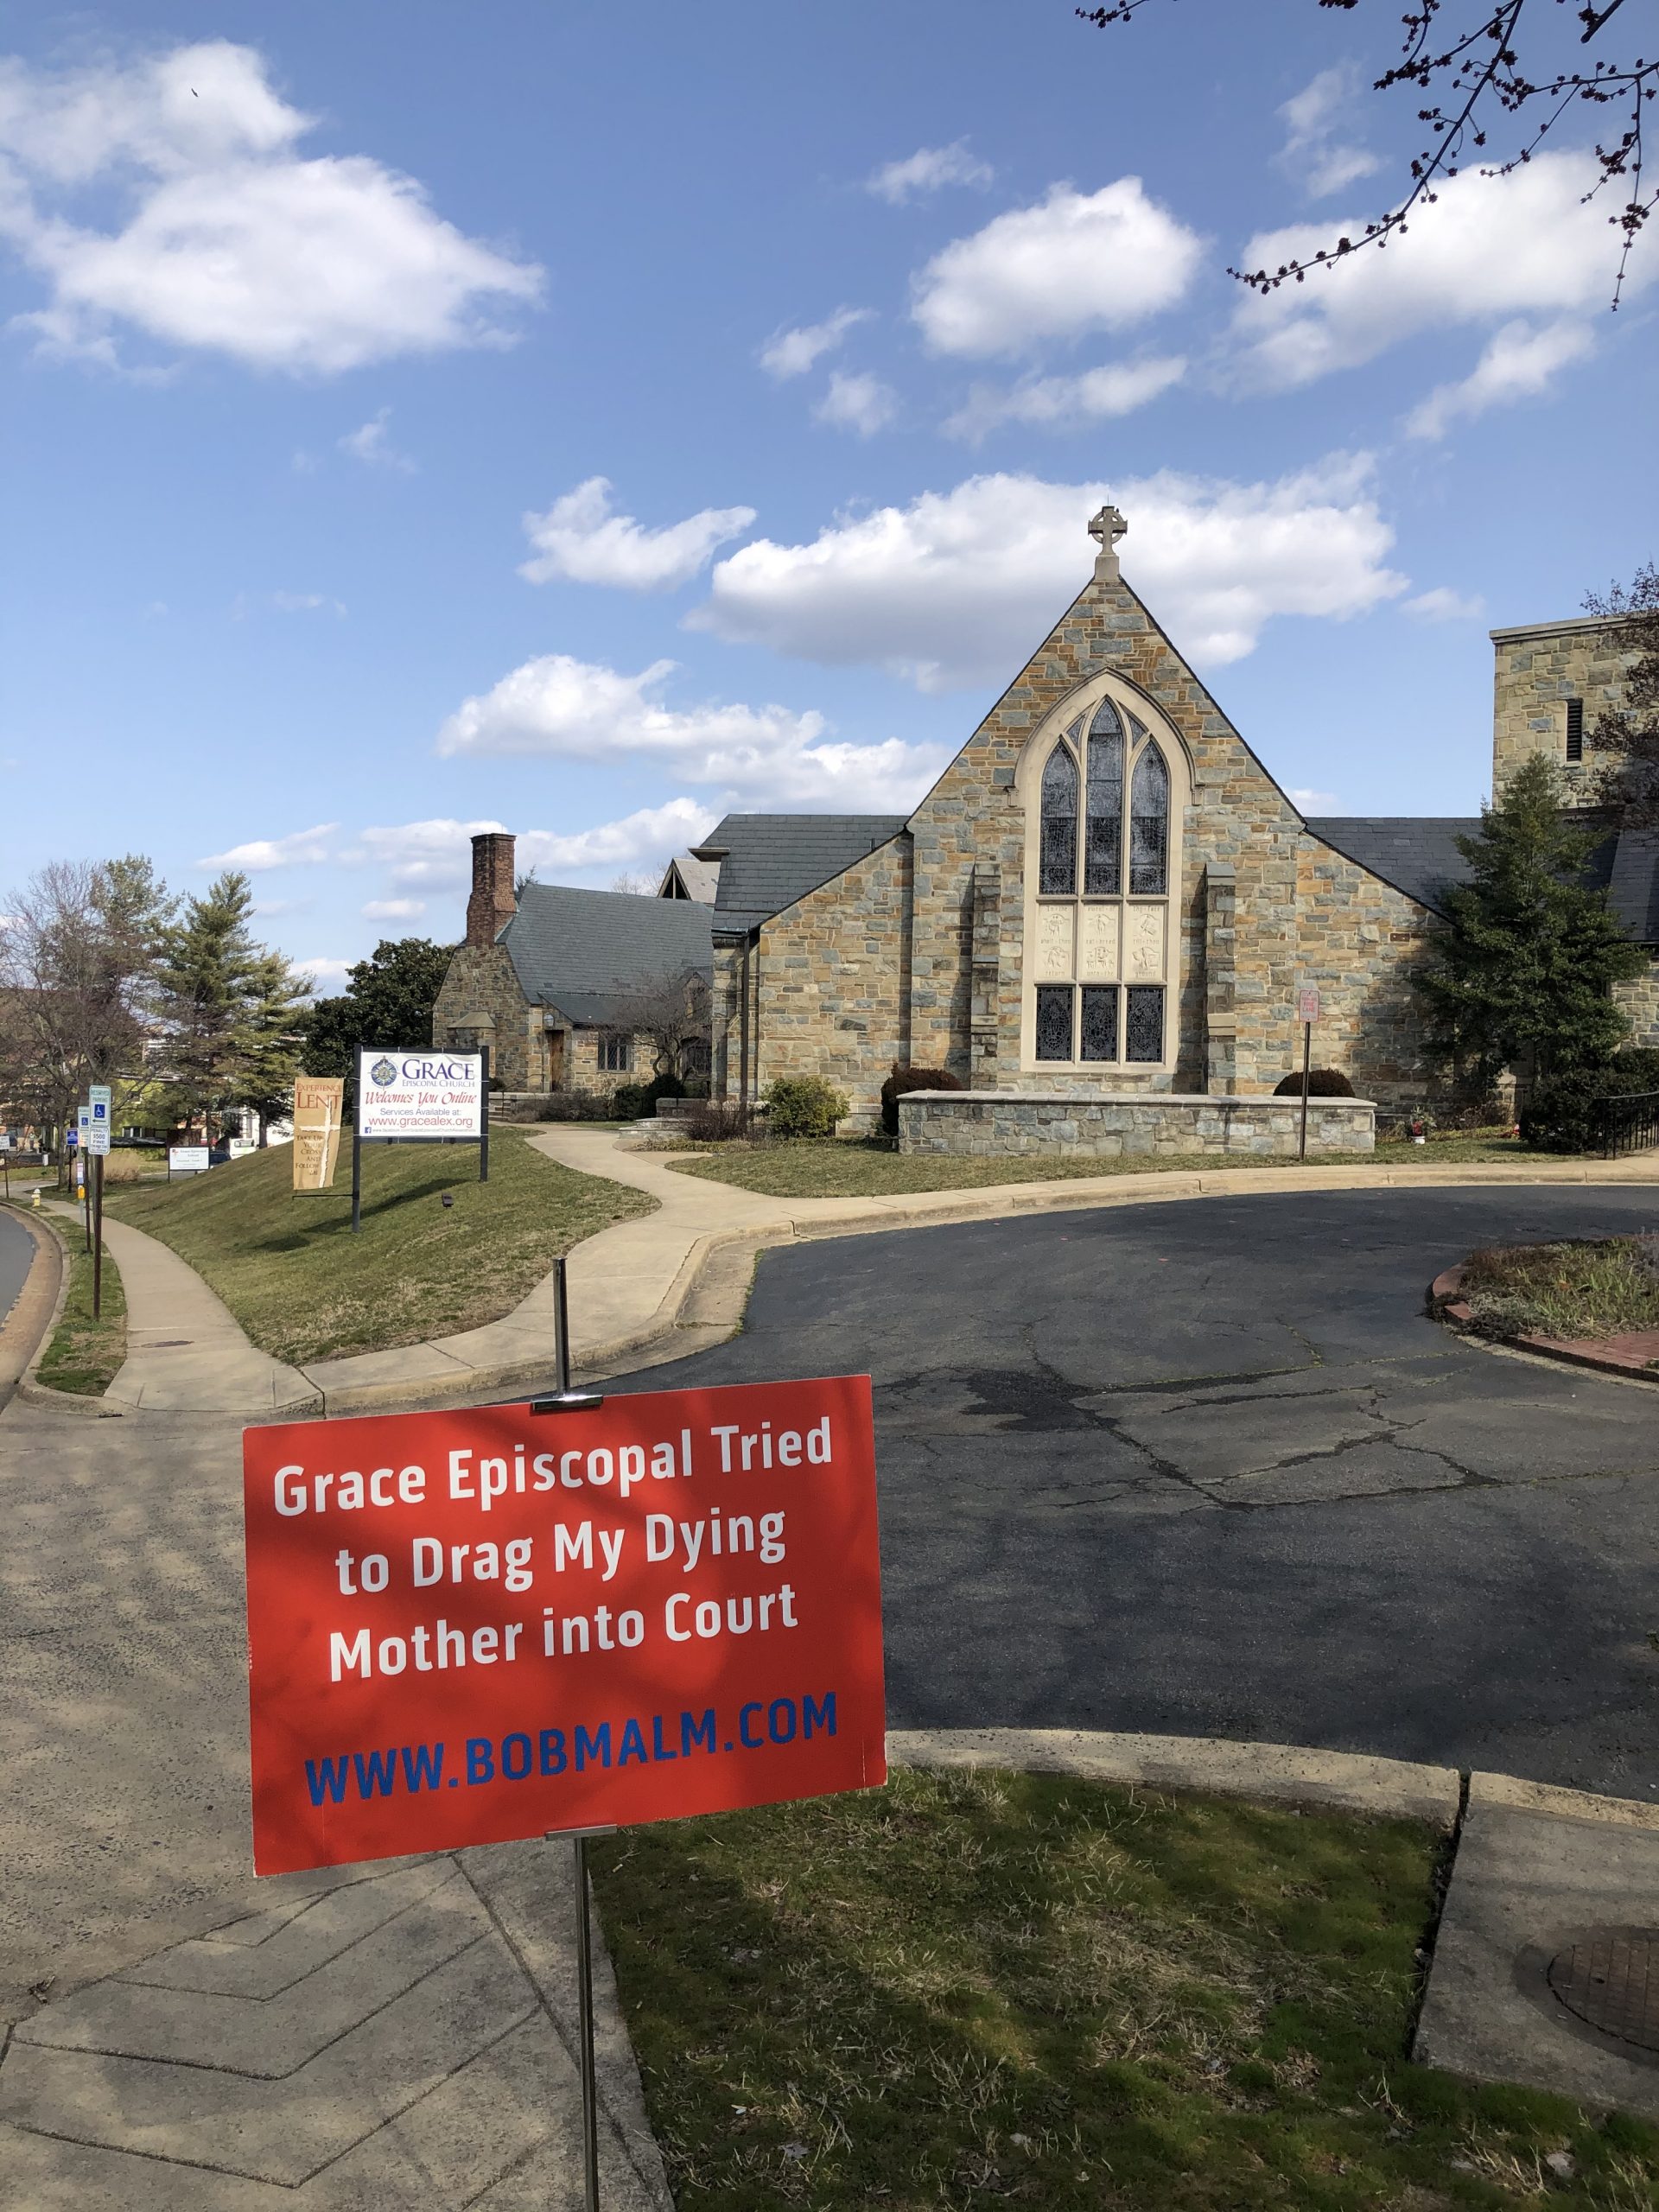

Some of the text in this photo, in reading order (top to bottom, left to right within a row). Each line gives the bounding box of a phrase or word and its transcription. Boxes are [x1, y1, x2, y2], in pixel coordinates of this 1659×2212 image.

[402, 1058, 475, 1080] GRACE
[296, 1083, 342, 1092] EXPERIENCE
[365, 1090, 478, 1107] Welcomes You Online
[296, 1091, 342, 1109] LENT
[368, 1116, 474, 1128] www.gracealex.org
[274, 1416, 833, 1516] Grace Episcopal Tried
[334, 1507, 786, 1596] to Drag My Dying
[329, 1584, 798, 1683] Mother into Court
[304, 1692, 838, 1807] WWW.BOBMALM.COM
